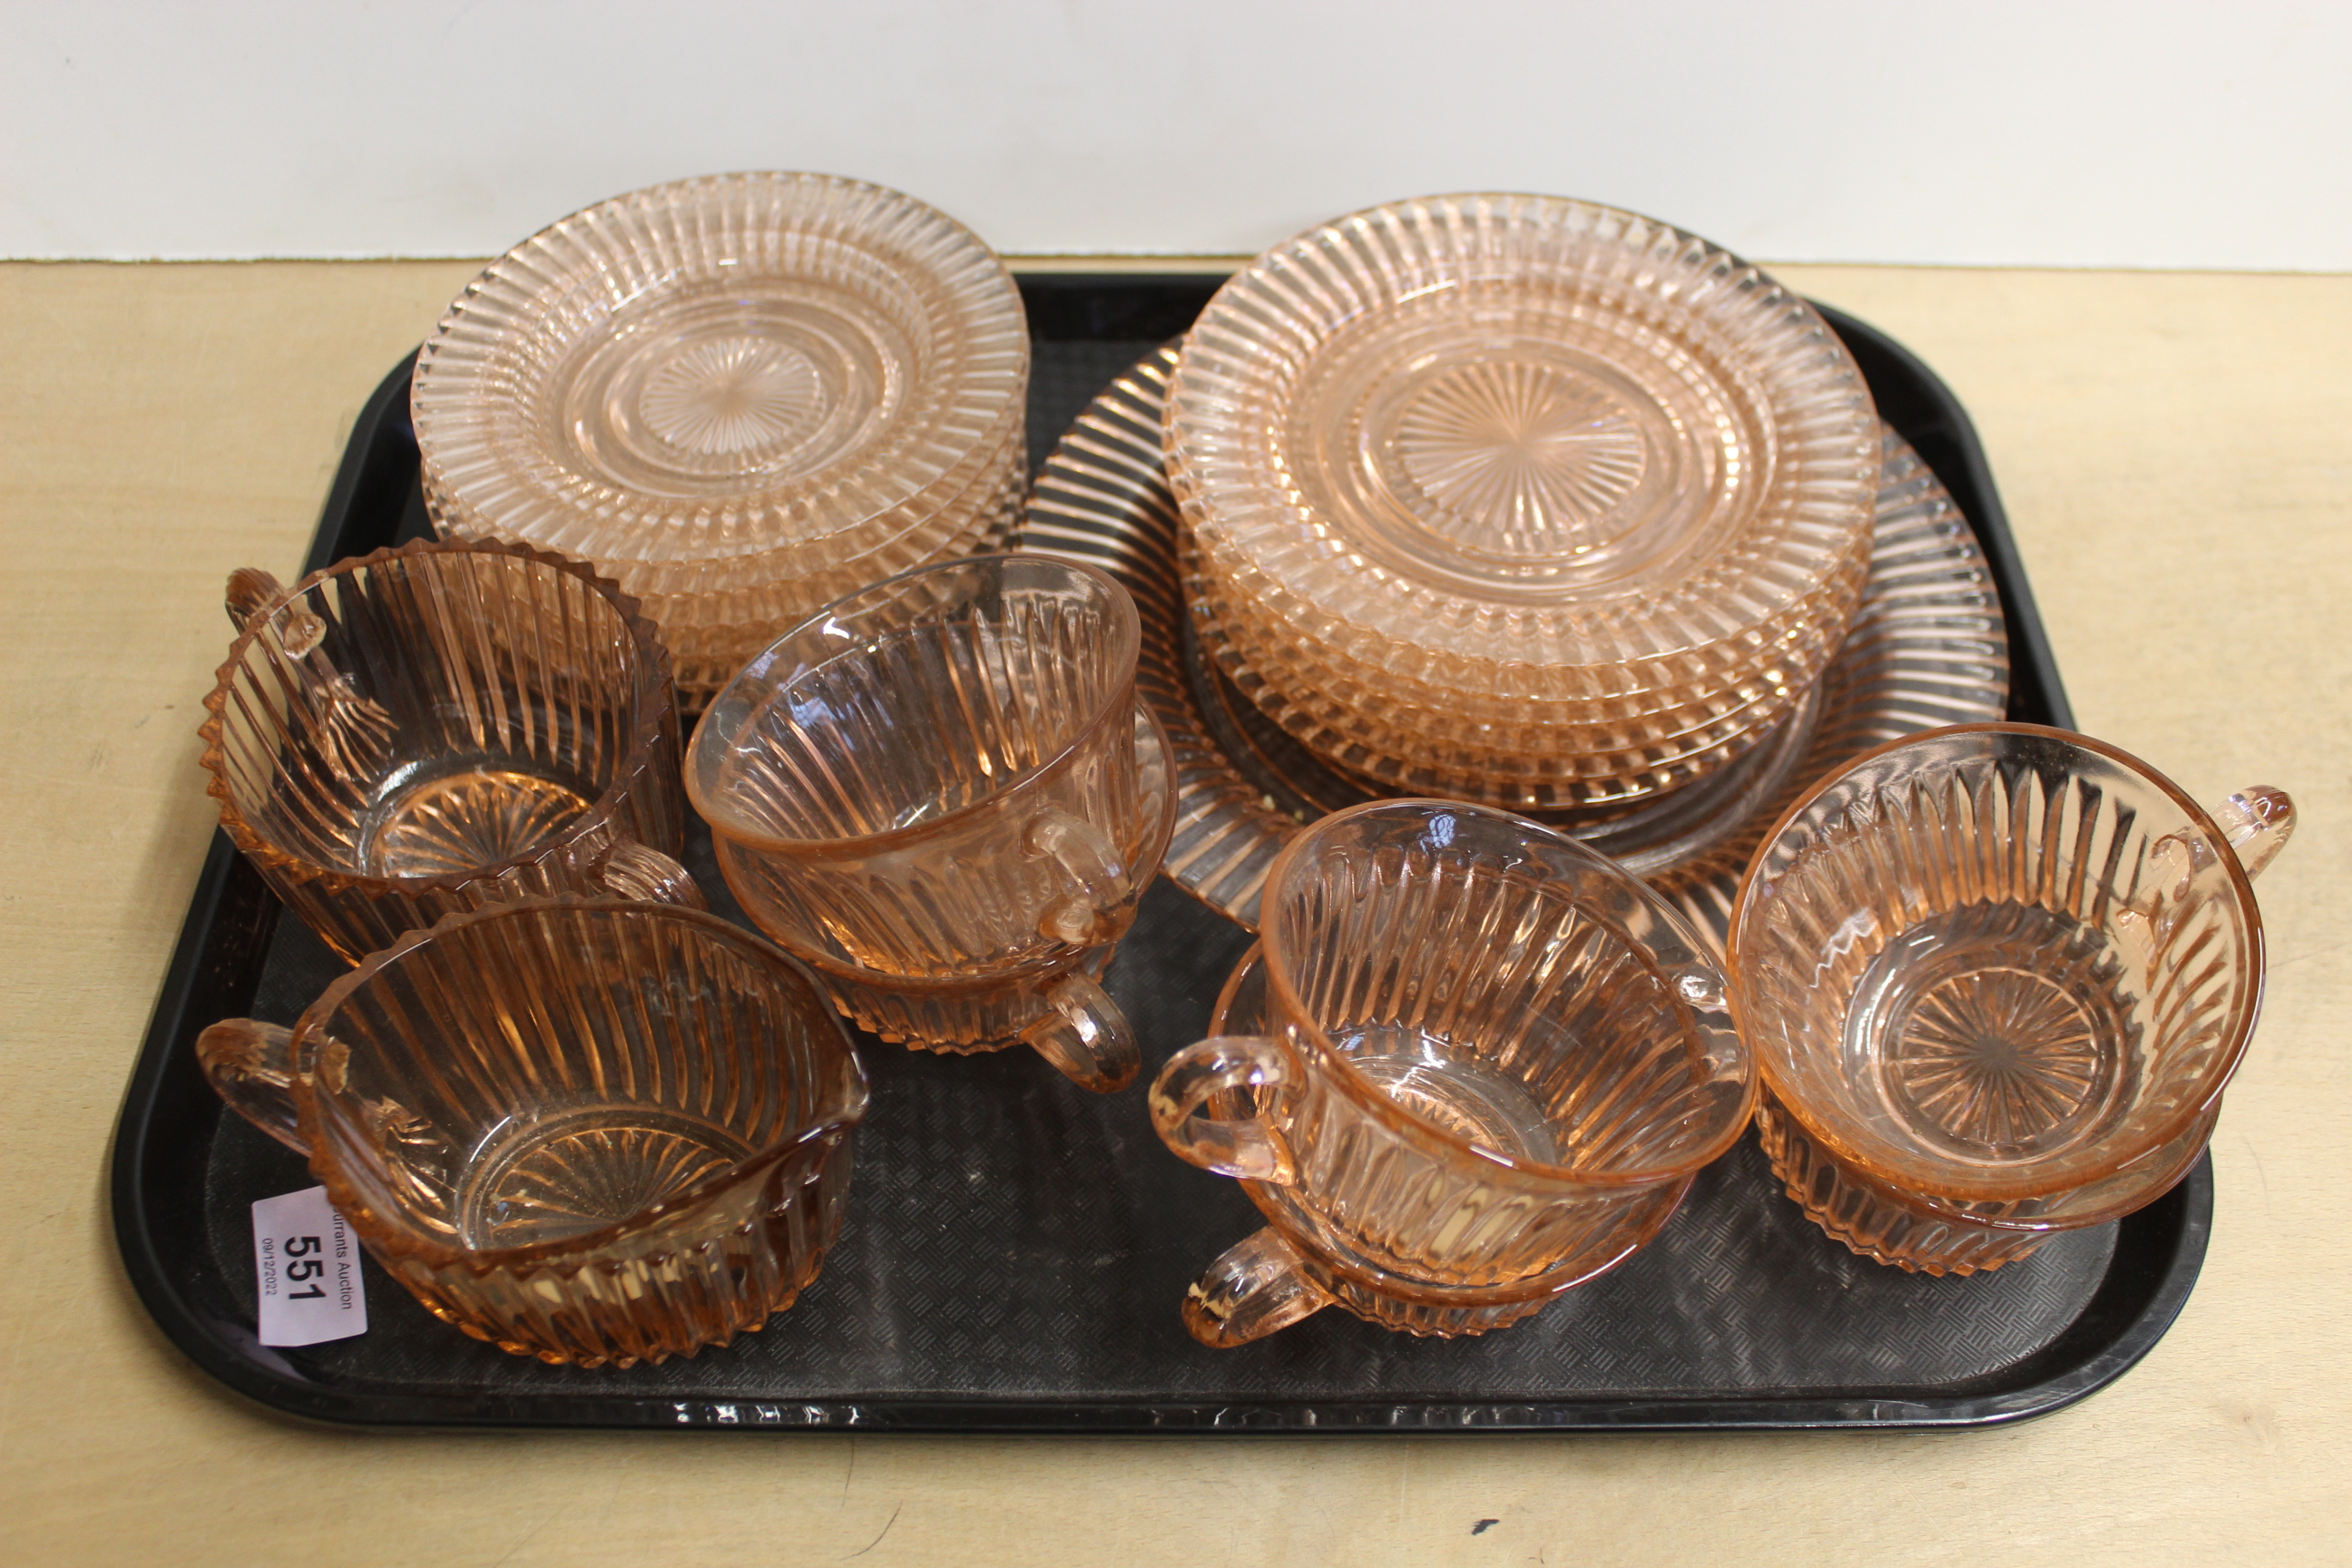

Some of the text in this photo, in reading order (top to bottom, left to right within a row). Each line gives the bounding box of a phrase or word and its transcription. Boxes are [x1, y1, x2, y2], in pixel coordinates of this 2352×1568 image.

[262, 1238, 278, 1296] 09/12/2022
[284, 1236, 327, 1299] 551
[333, 1207, 355, 1309] urrants Auction
